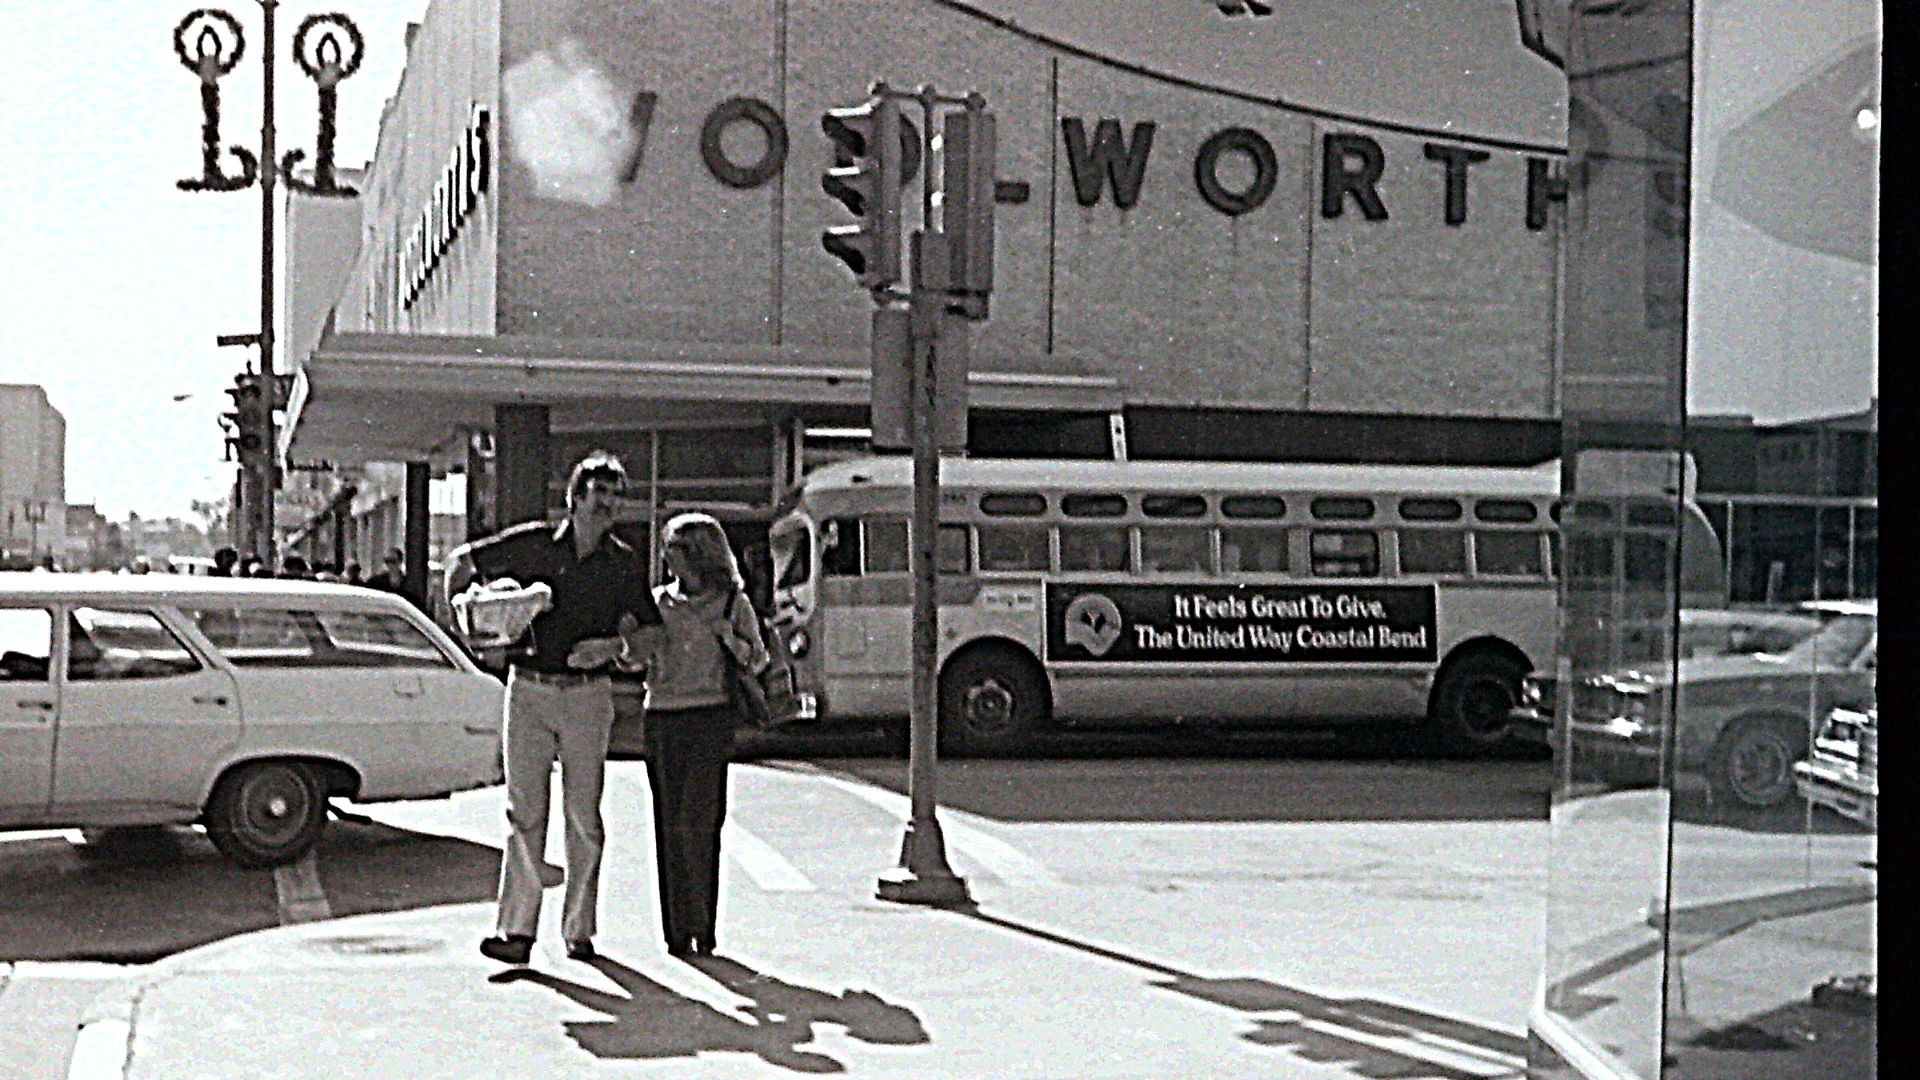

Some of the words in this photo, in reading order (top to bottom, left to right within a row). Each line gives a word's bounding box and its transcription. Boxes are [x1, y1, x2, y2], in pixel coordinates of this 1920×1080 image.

[1174, 594, 1190, 618] It
[1194, 594, 1247, 618] Feels
[1251, 594, 1308, 618] Great
[1308, 594, 1333, 618] To
[1134, 624, 1173, 648] The
[1176, 624, 1245, 648] United
[1248, 624, 1293, 653] Way
[1296, 624, 1375, 648] Coastal
[1378, 624, 1427, 648] Bend
